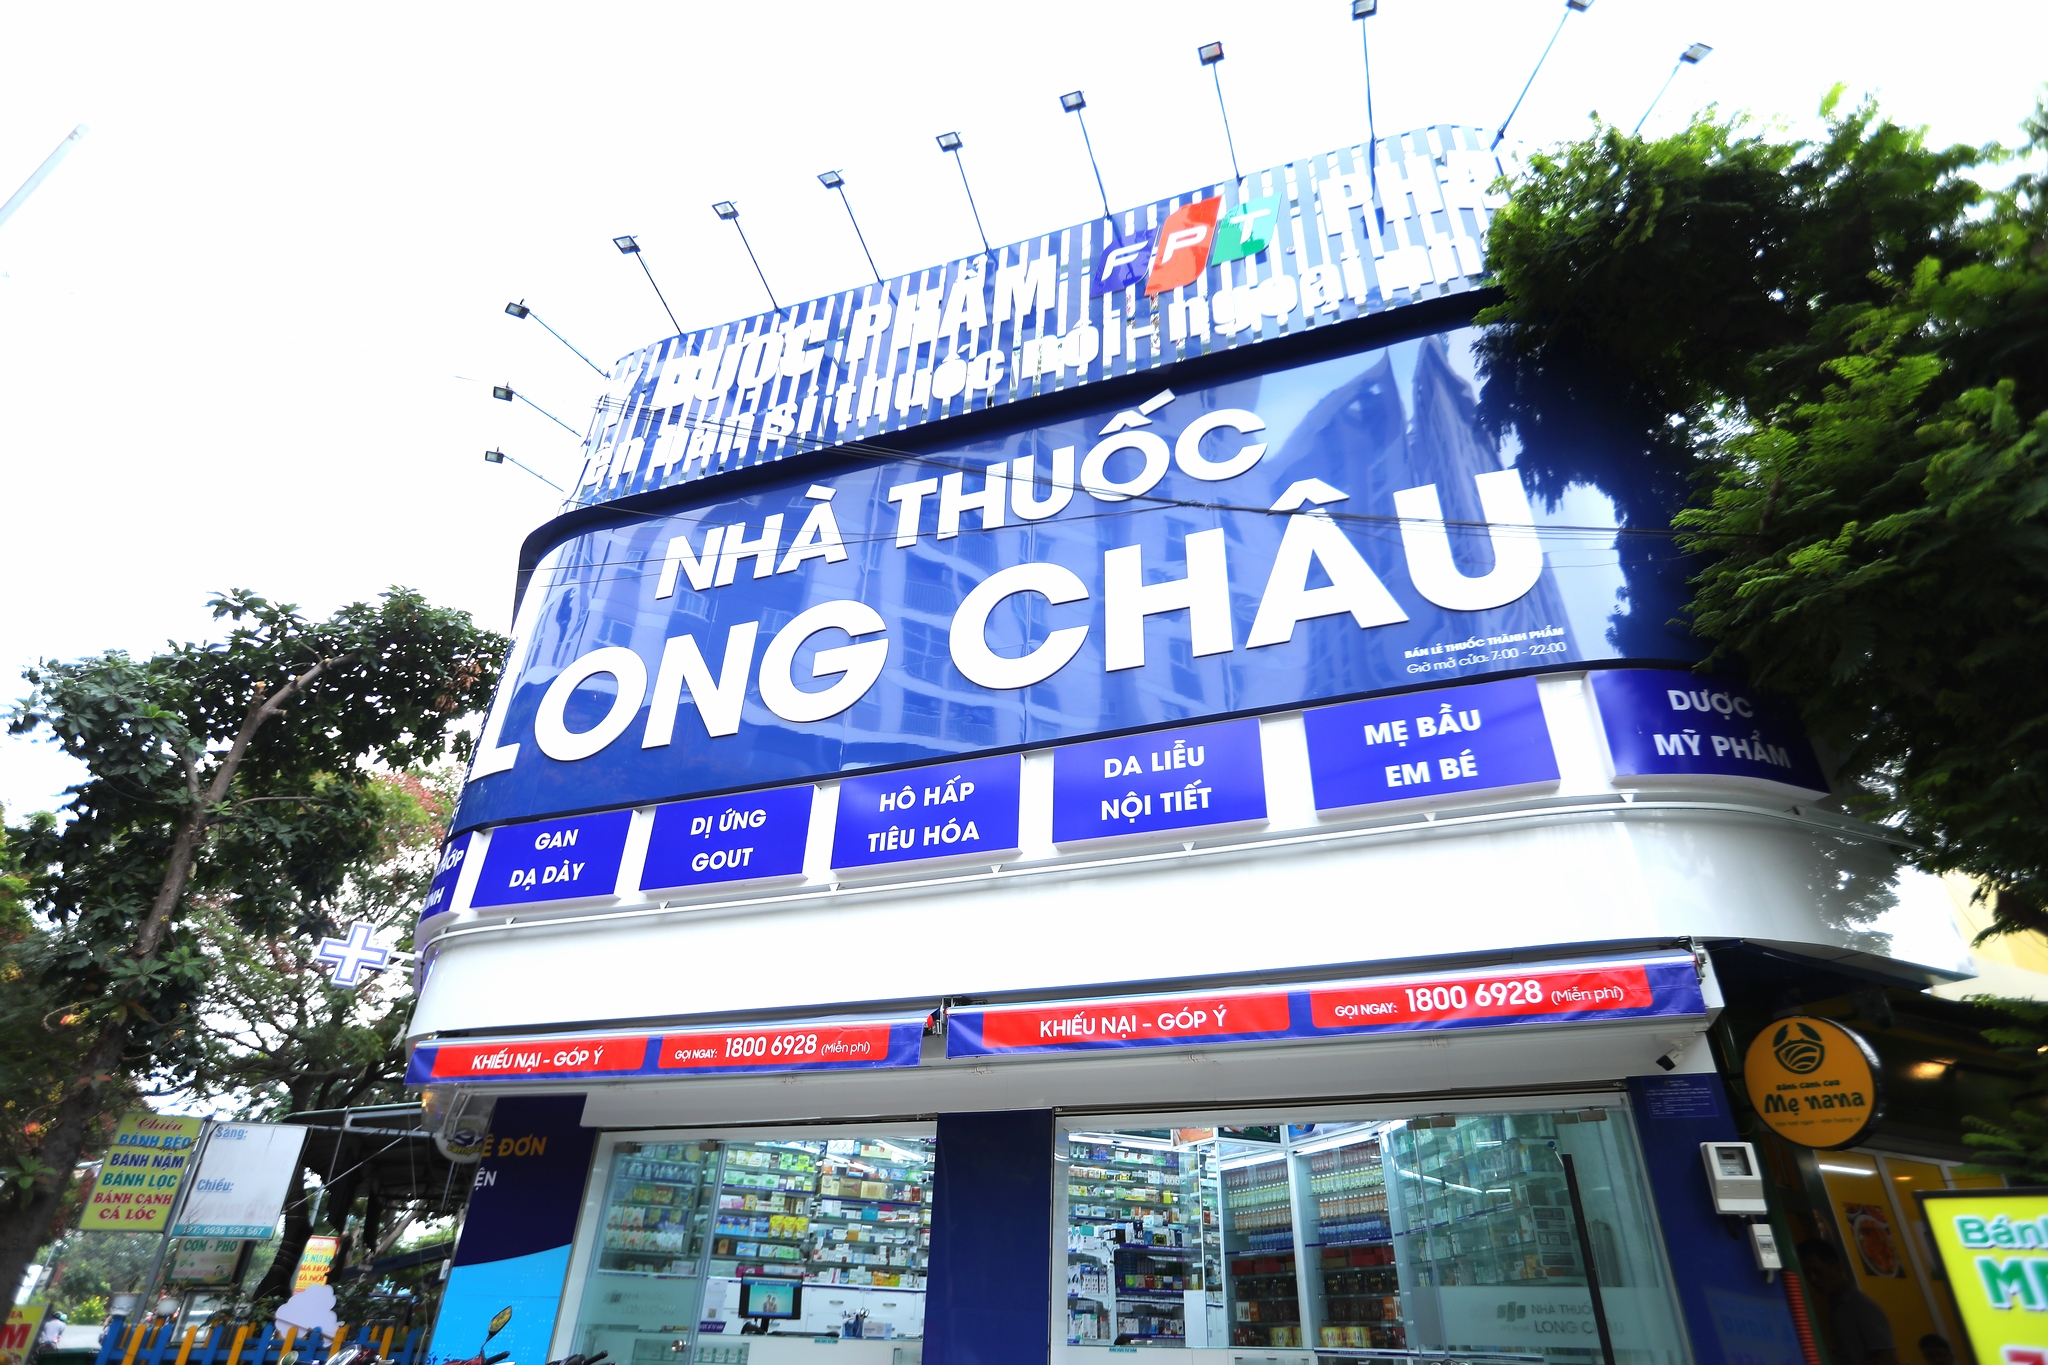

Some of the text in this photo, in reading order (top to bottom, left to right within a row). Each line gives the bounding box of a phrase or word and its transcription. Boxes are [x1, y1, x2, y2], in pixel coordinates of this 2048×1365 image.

[1098, 205, 1274, 284] FPT
[655, 388, 1268, 599] NHÀ THUỐC
[464, 468, 1543, 780] LONG CHÂU
[1404, 647, 1429, 658] BÁN
[1444, 636, 1485, 652] THUỐC
[1487, 632, 1527, 646] THÀNH
[1529, 624, 1564, 640] PHẨM
[1406, 661, 1431, 674] Giờ
[1434, 657, 1456, 671] mở
[1491, 648, 1519, 661] 7:00
[1529, 642, 1567, 656] 22:00
[1667, 688, 1753, 719] DƯỢC
[1364, 703, 1482, 747] MẸ BẦU
[1103, 738, 1205, 779] DA LIỄU
[1653, 728, 1792, 769] MỸ PHẨM
[1385, 748, 1479, 788] EM BÉ
[878, 775, 975, 812] HÔ HẤP
[1100, 779, 1212, 823] NỘI TIẾT
[690, 808, 767, 839] DỊ ỨNG
[867, 818, 980, 853] TIÊU HÓA
[534, 828, 579, 851] GAN
[691, 847, 754, 872] GOUT
[508, 859, 586, 892] DẠ DÀY
[1334, 980, 1624, 1019] GỌI NGAY: 1800 6928 (Miễn phí)
[1039, 1011, 1096, 1038] KHIẾU
[1101, 1015, 1137, 1038] NẠI
[1157, 1006, 1207, 1030] GÓP
[1212, 1004, 1227, 1027] Ý
[471, 1048, 512, 1070] KHIẾU
[514, 1052, 542, 1072] NẠI
[553, 1046, 590, 1066] GÓP
[593, 1045, 604, 1065] Ý
[674, 1034, 871, 1062] GỌI NGAY: 1800 6928 (Miễn phí)
[1764, 1091, 1865, 1116] Mẹ nana
[118, 1132, 161, 1148] BÁNH
[215, 1126, 249, 1139] Sáng:
[498, 1133, 548, 1157] ĐƠN
[110, 1151, 186, 1171] BÁNH NẬM
[101, 1170, 178, 1190] BÁNH LỌC
[93, 1190, 174, 1205] BÁNH CANH
[98, 1206, 157, 1220] CÁ LÓC
[203, 1226, 227, 1235] 0938
[227, 1227, 245, 1235] 526
[1531, 1302, 1594, 1315] NHÀ THUỐ
[1534, 1320, 1578, 1334] LONG
